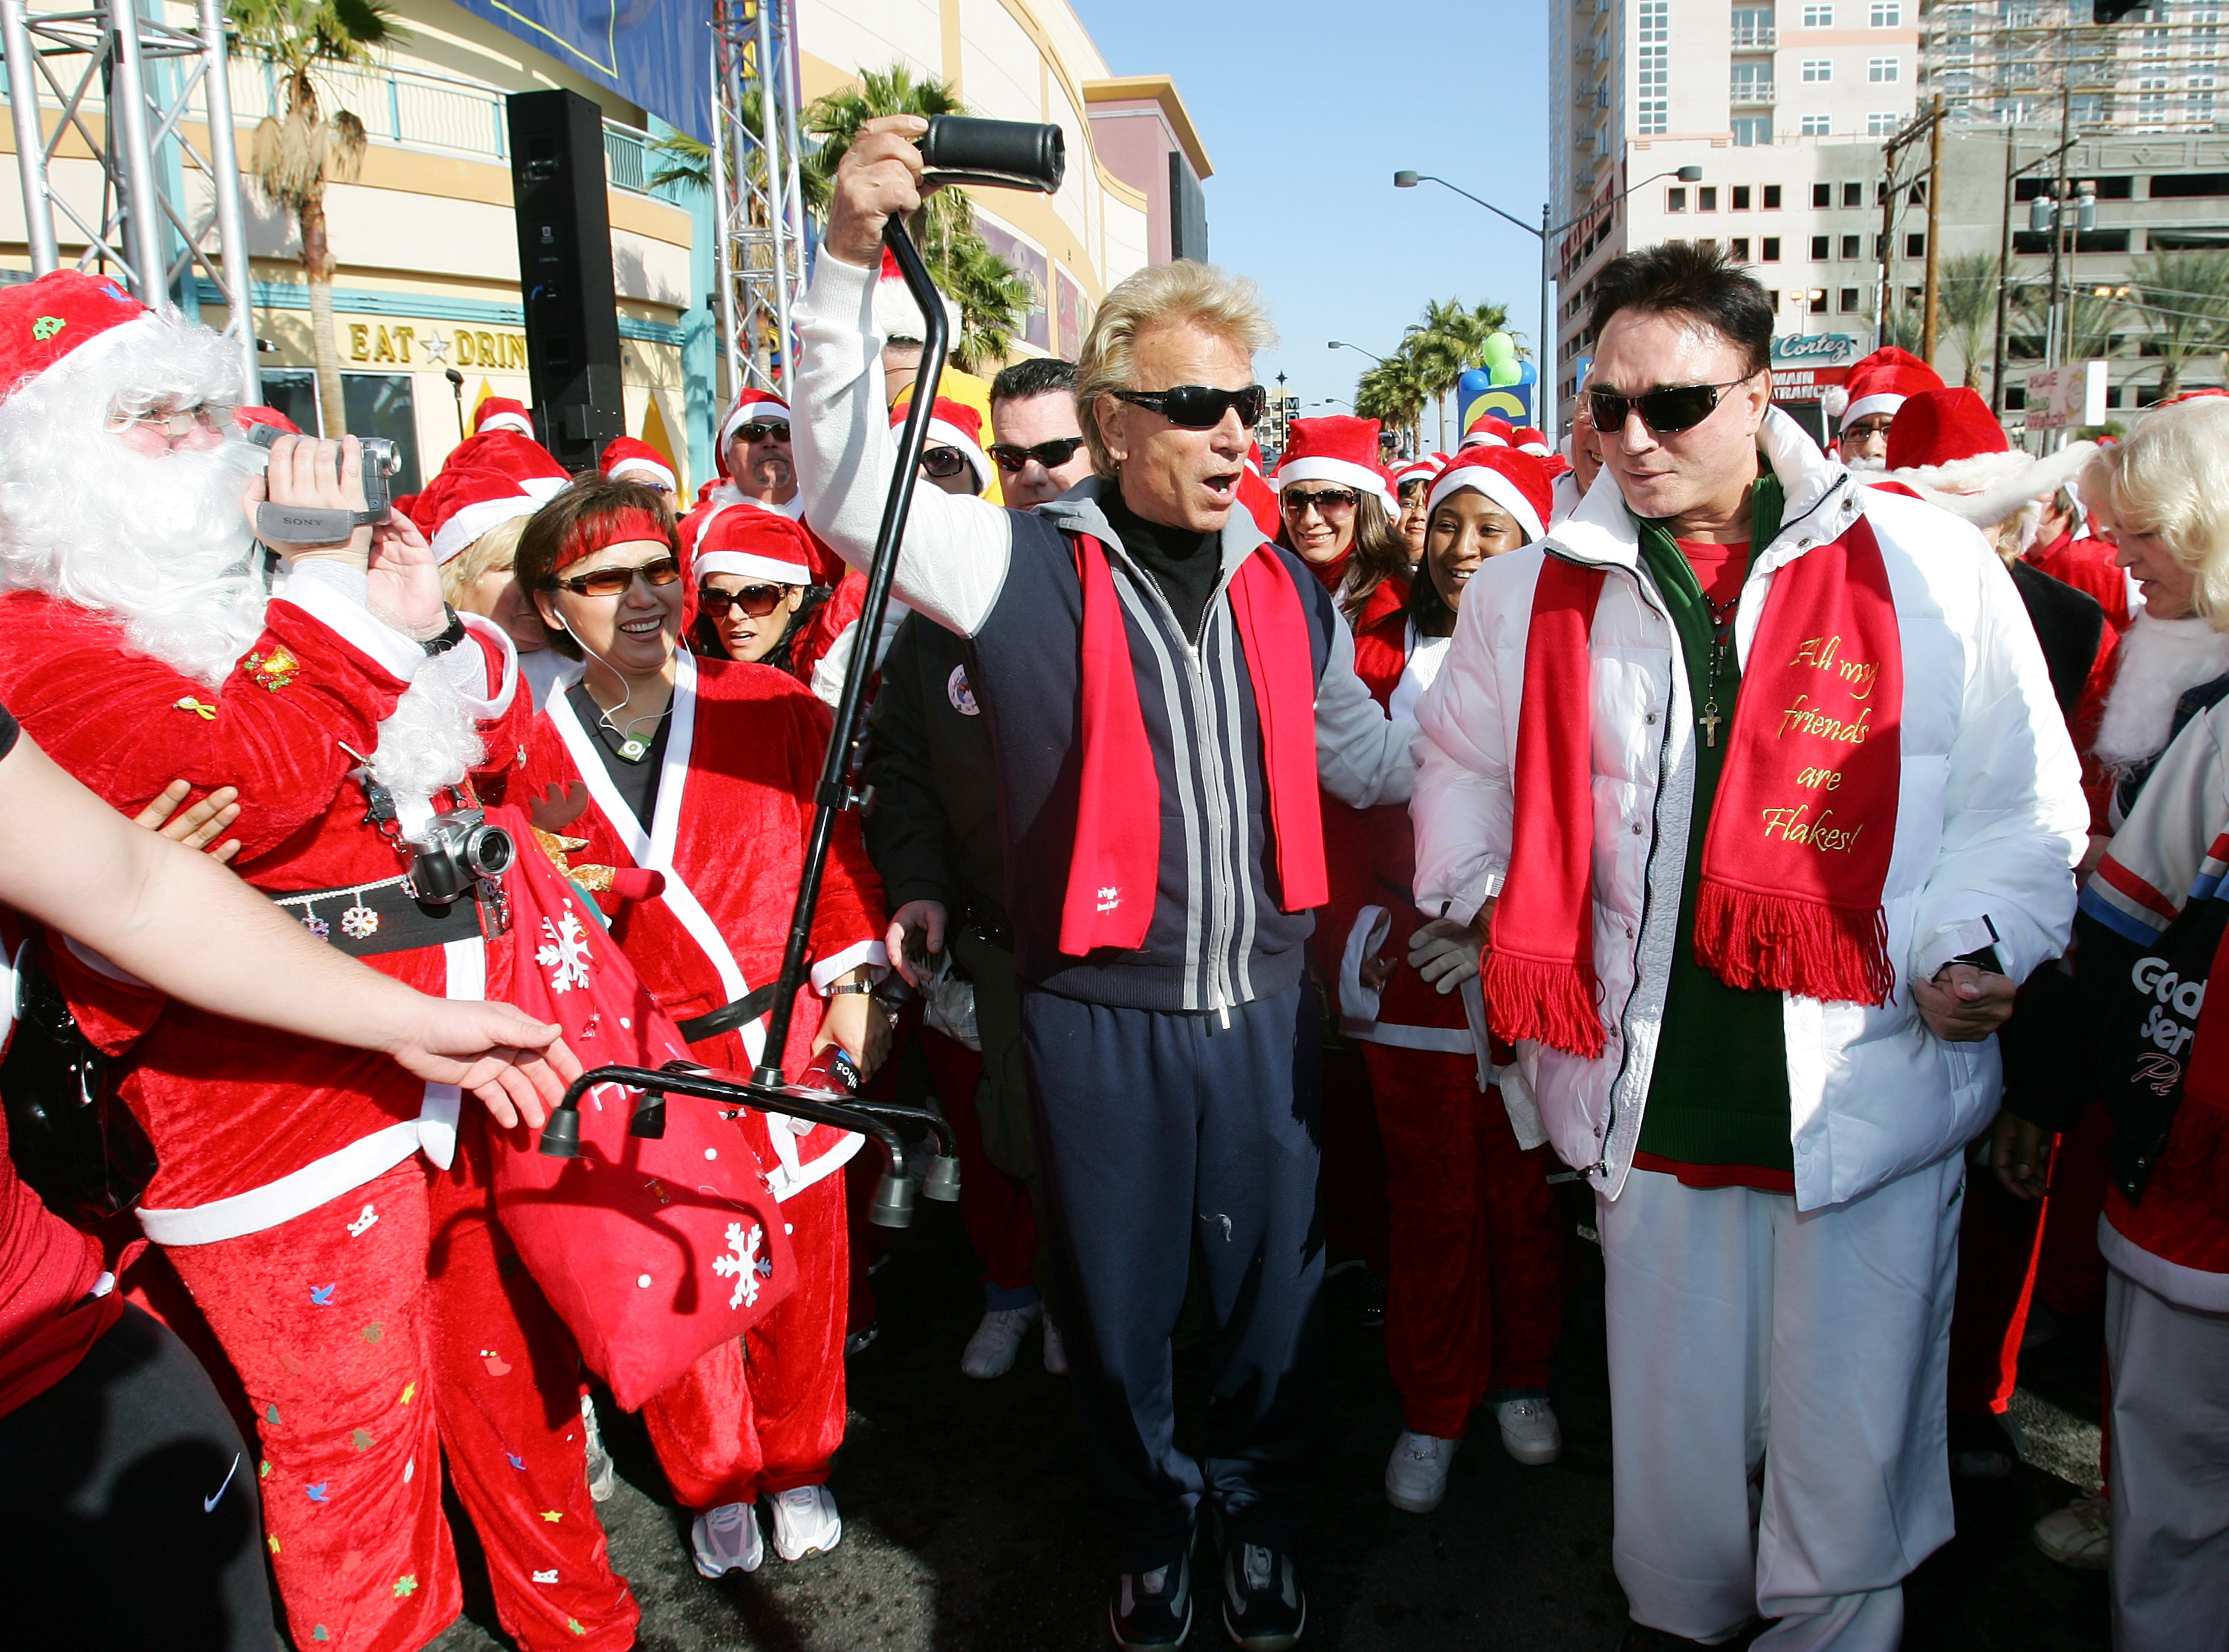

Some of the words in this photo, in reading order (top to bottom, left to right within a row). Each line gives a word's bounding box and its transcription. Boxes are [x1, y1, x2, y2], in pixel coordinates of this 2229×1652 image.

[349, 324, 415, 362] EAT
[454, 329, 527, 369] DRIN
[1779, 333, 1848, 363] Cortez
[1772, 371, 1814, 386] MAIN
[283, 517, 323, 527] SONY
[1790, 635, 1841, 670] All
[1840, 660, 1880, 700] my
[1778, 695, 1872, 744] friends
[1797, 767, 1841, 791] are
[1762, 804, 1865, 853] Flakes!
[2141, 1004, 2196, 1056] ser
